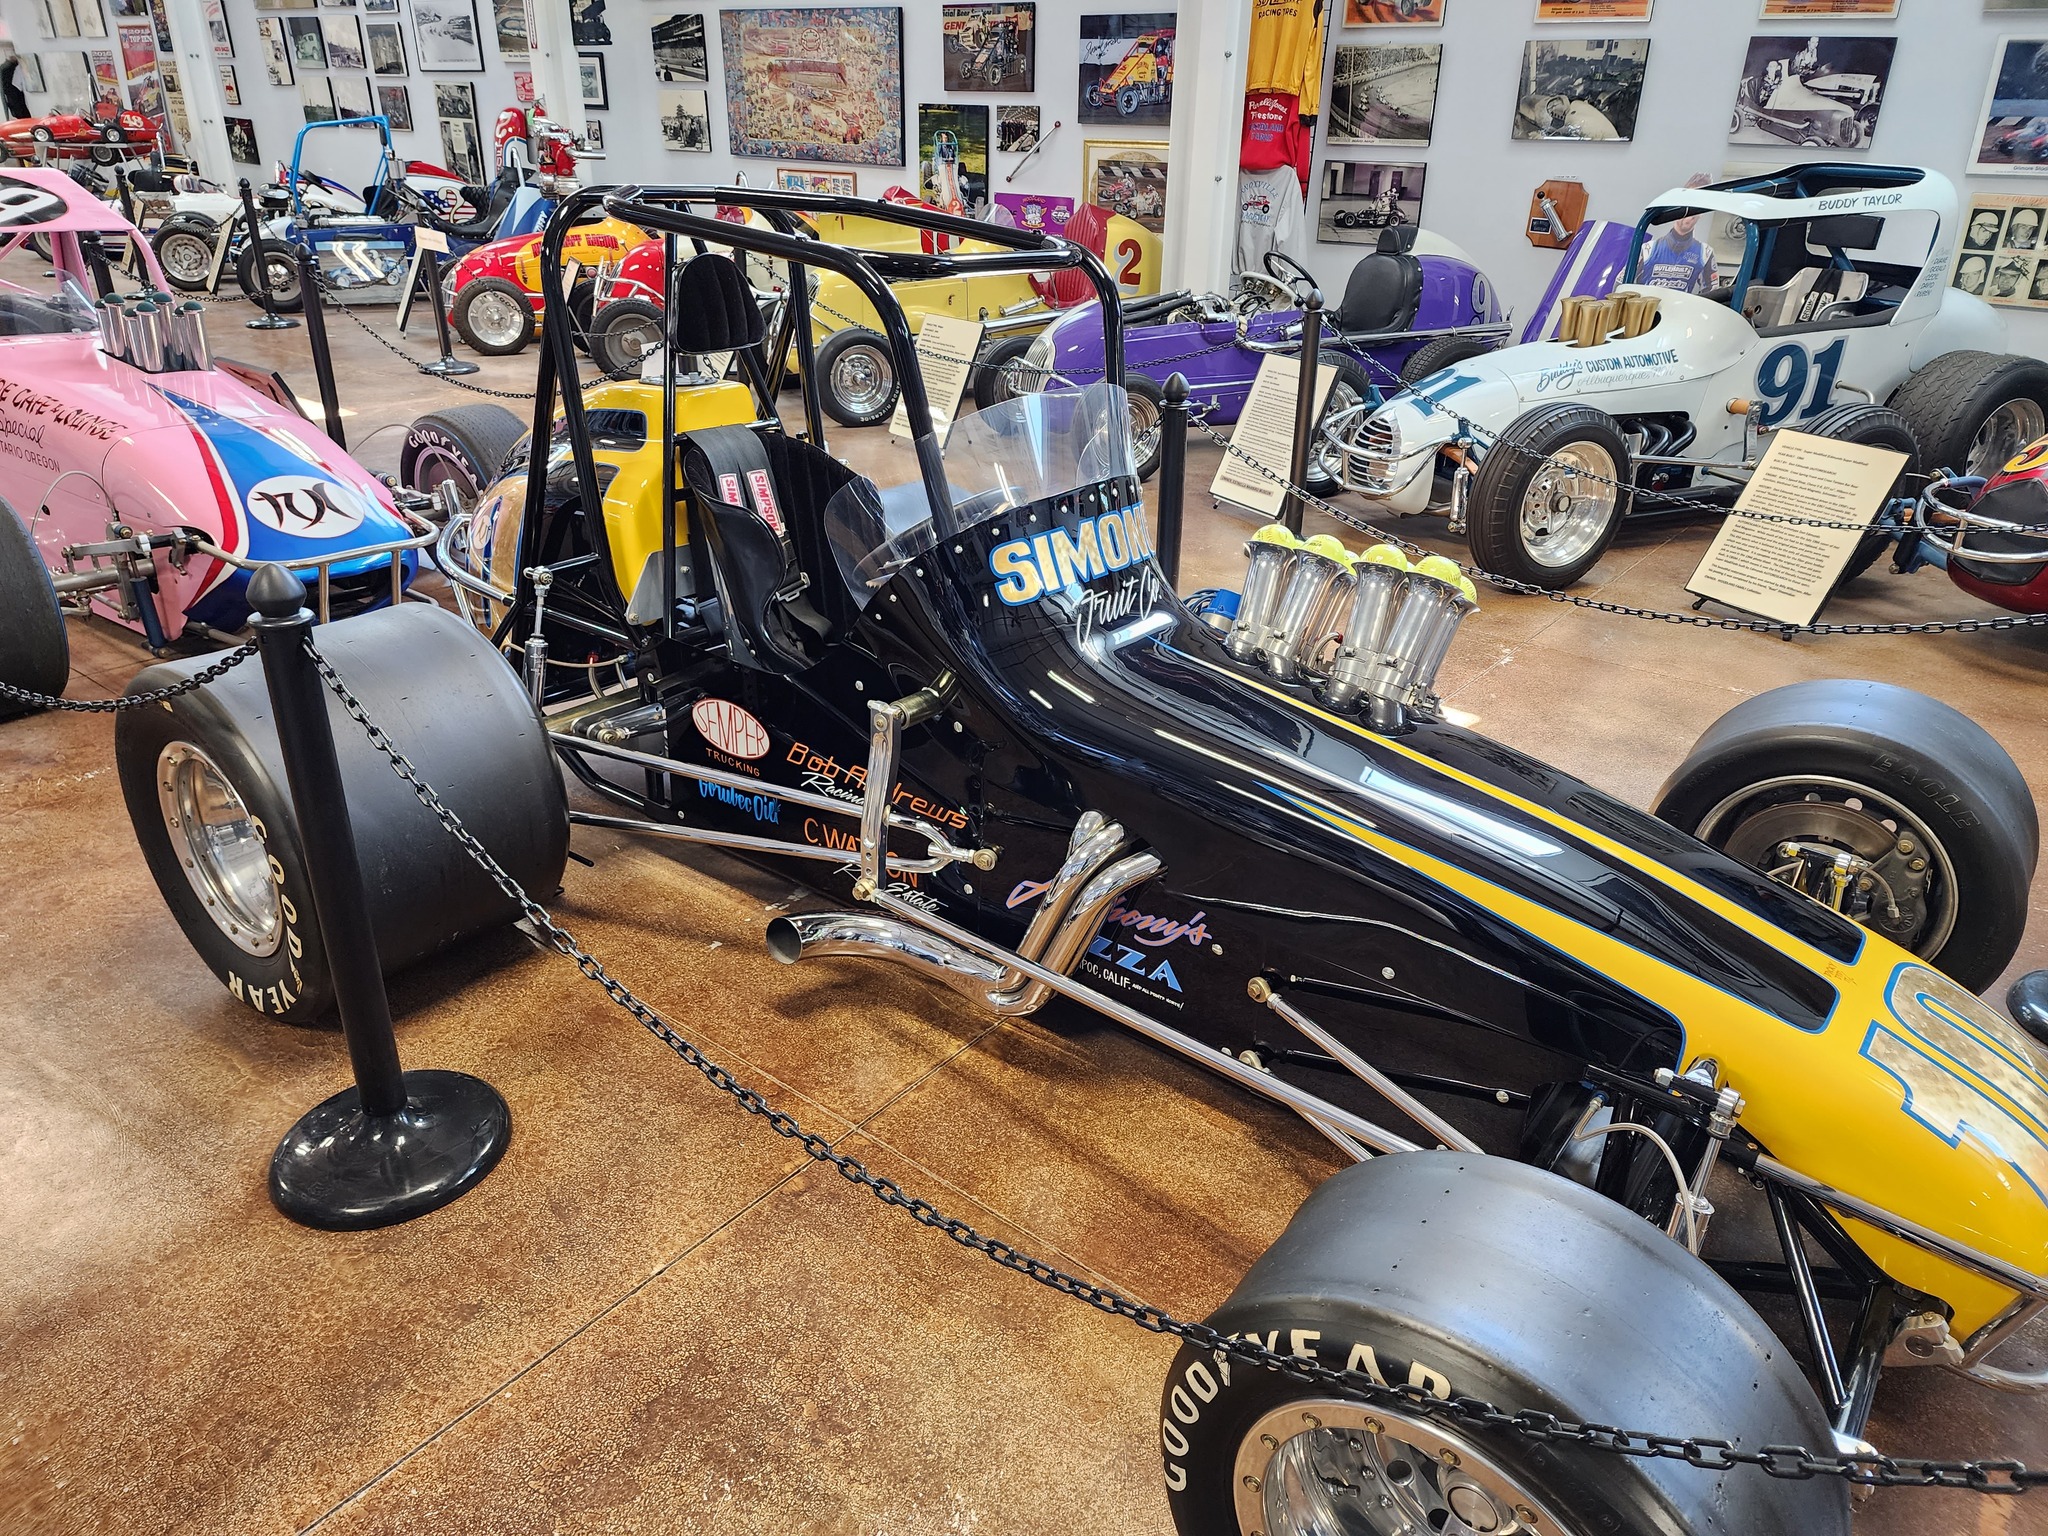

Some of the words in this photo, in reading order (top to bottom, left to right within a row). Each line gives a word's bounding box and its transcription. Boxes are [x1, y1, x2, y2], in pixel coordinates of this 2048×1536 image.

[122, 114, 144, 128] 48
[1053, 212, 1070, 222] CRA
[1818, 198, 1859, 210] BUDDY
[1862, 194, 1902, 205] TAYLOR
[1116, 239, 1142, 290] 2
[1536, 359, 1584, 392] Buddy's
[1586, 358, 1622, 373] CUSTOM
[1624, 348, 1679, 368] AUTOMOTIVE
[1756, 337, 1847, 426] 91
[12, 388, 60, 416] CAFE
[54, 408, 128, 440] LOUNGE
[860, 404, 892, 422] RIVERSIDE
[24, 450, 60, 474] OREGON
[1074, 576, 1140, 650] Fruit
[694, 702, 766, 758] SEMPER
[706, 748, 761, 778] TRUCKING
[786, 742, 840, 779] Bob
[886, 882, 948, 912] Estate
[1102, 968, 1132, 990] CALIF.
